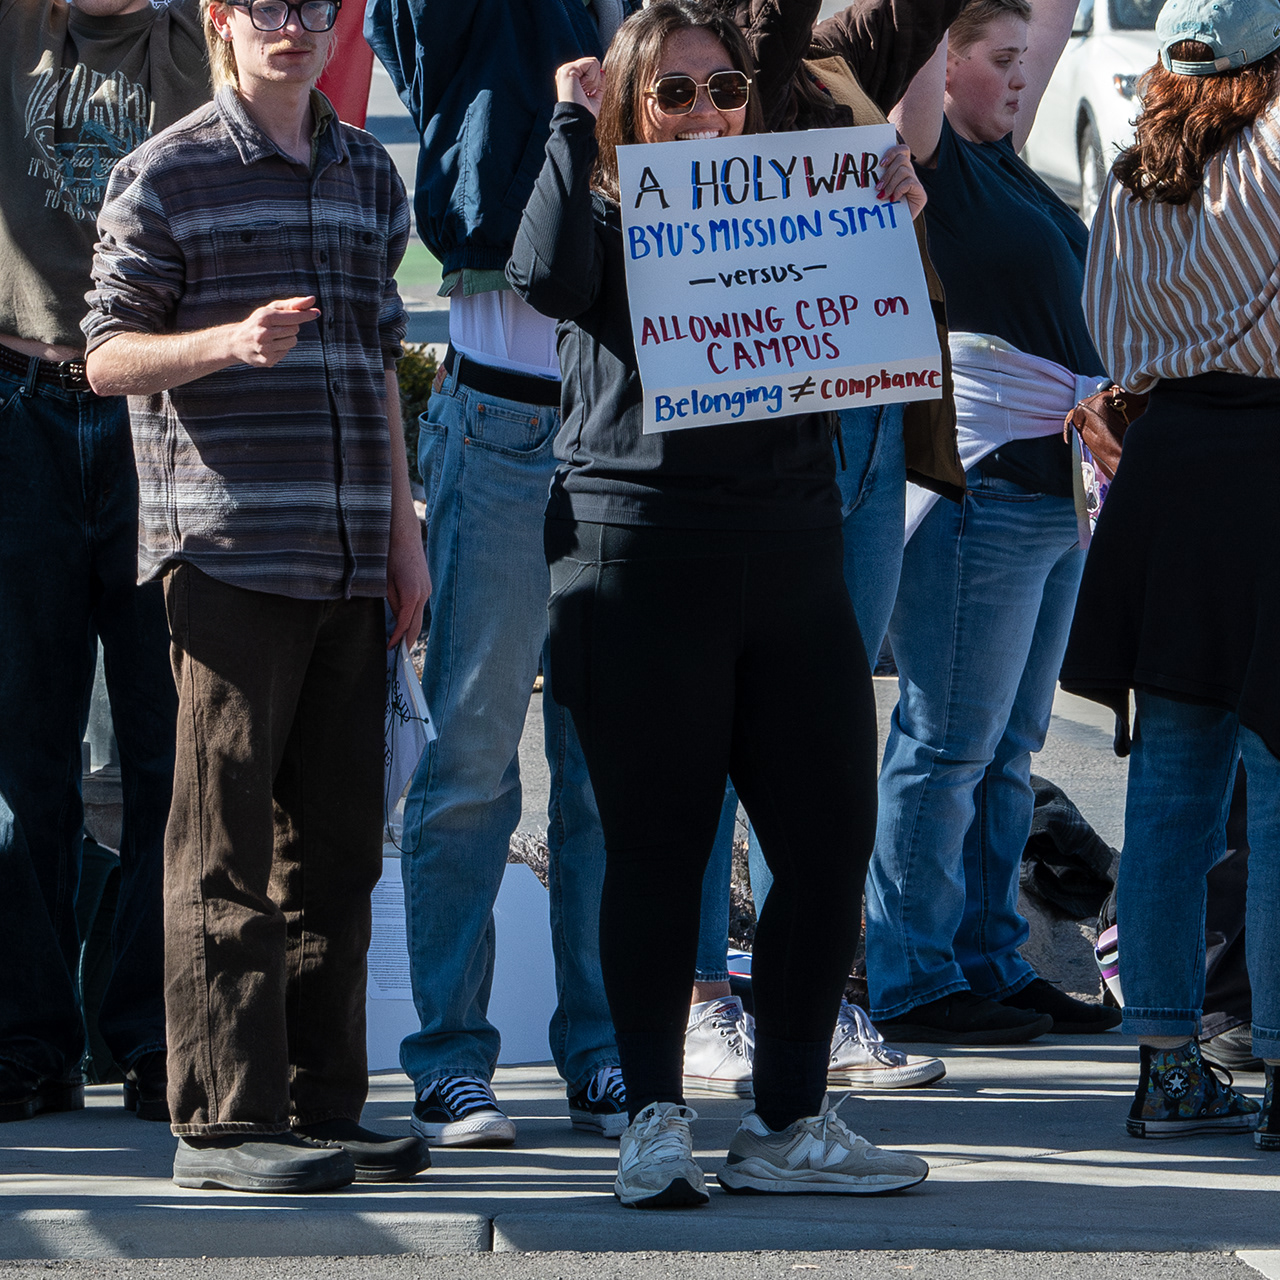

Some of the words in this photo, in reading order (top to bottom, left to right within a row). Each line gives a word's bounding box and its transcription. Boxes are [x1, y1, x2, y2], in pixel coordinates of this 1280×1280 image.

[634, 165, 670, 210] A
[691, 154, 797, 210] HOLY
[803, 152, 879, 197] WAR
[628, 221, 706, 261] BYU'S
[709, 210, 822, 252] MISSION
[830, 201, 901, 239] STMT
[641, 306, 785, 346] ALLOWING
[796, 294, 858, 331] CBP
[874, 295, 910, 318] on
[706, 333, 841, 375] CAMPUS
[655, 384, 782, 423] Belonging
